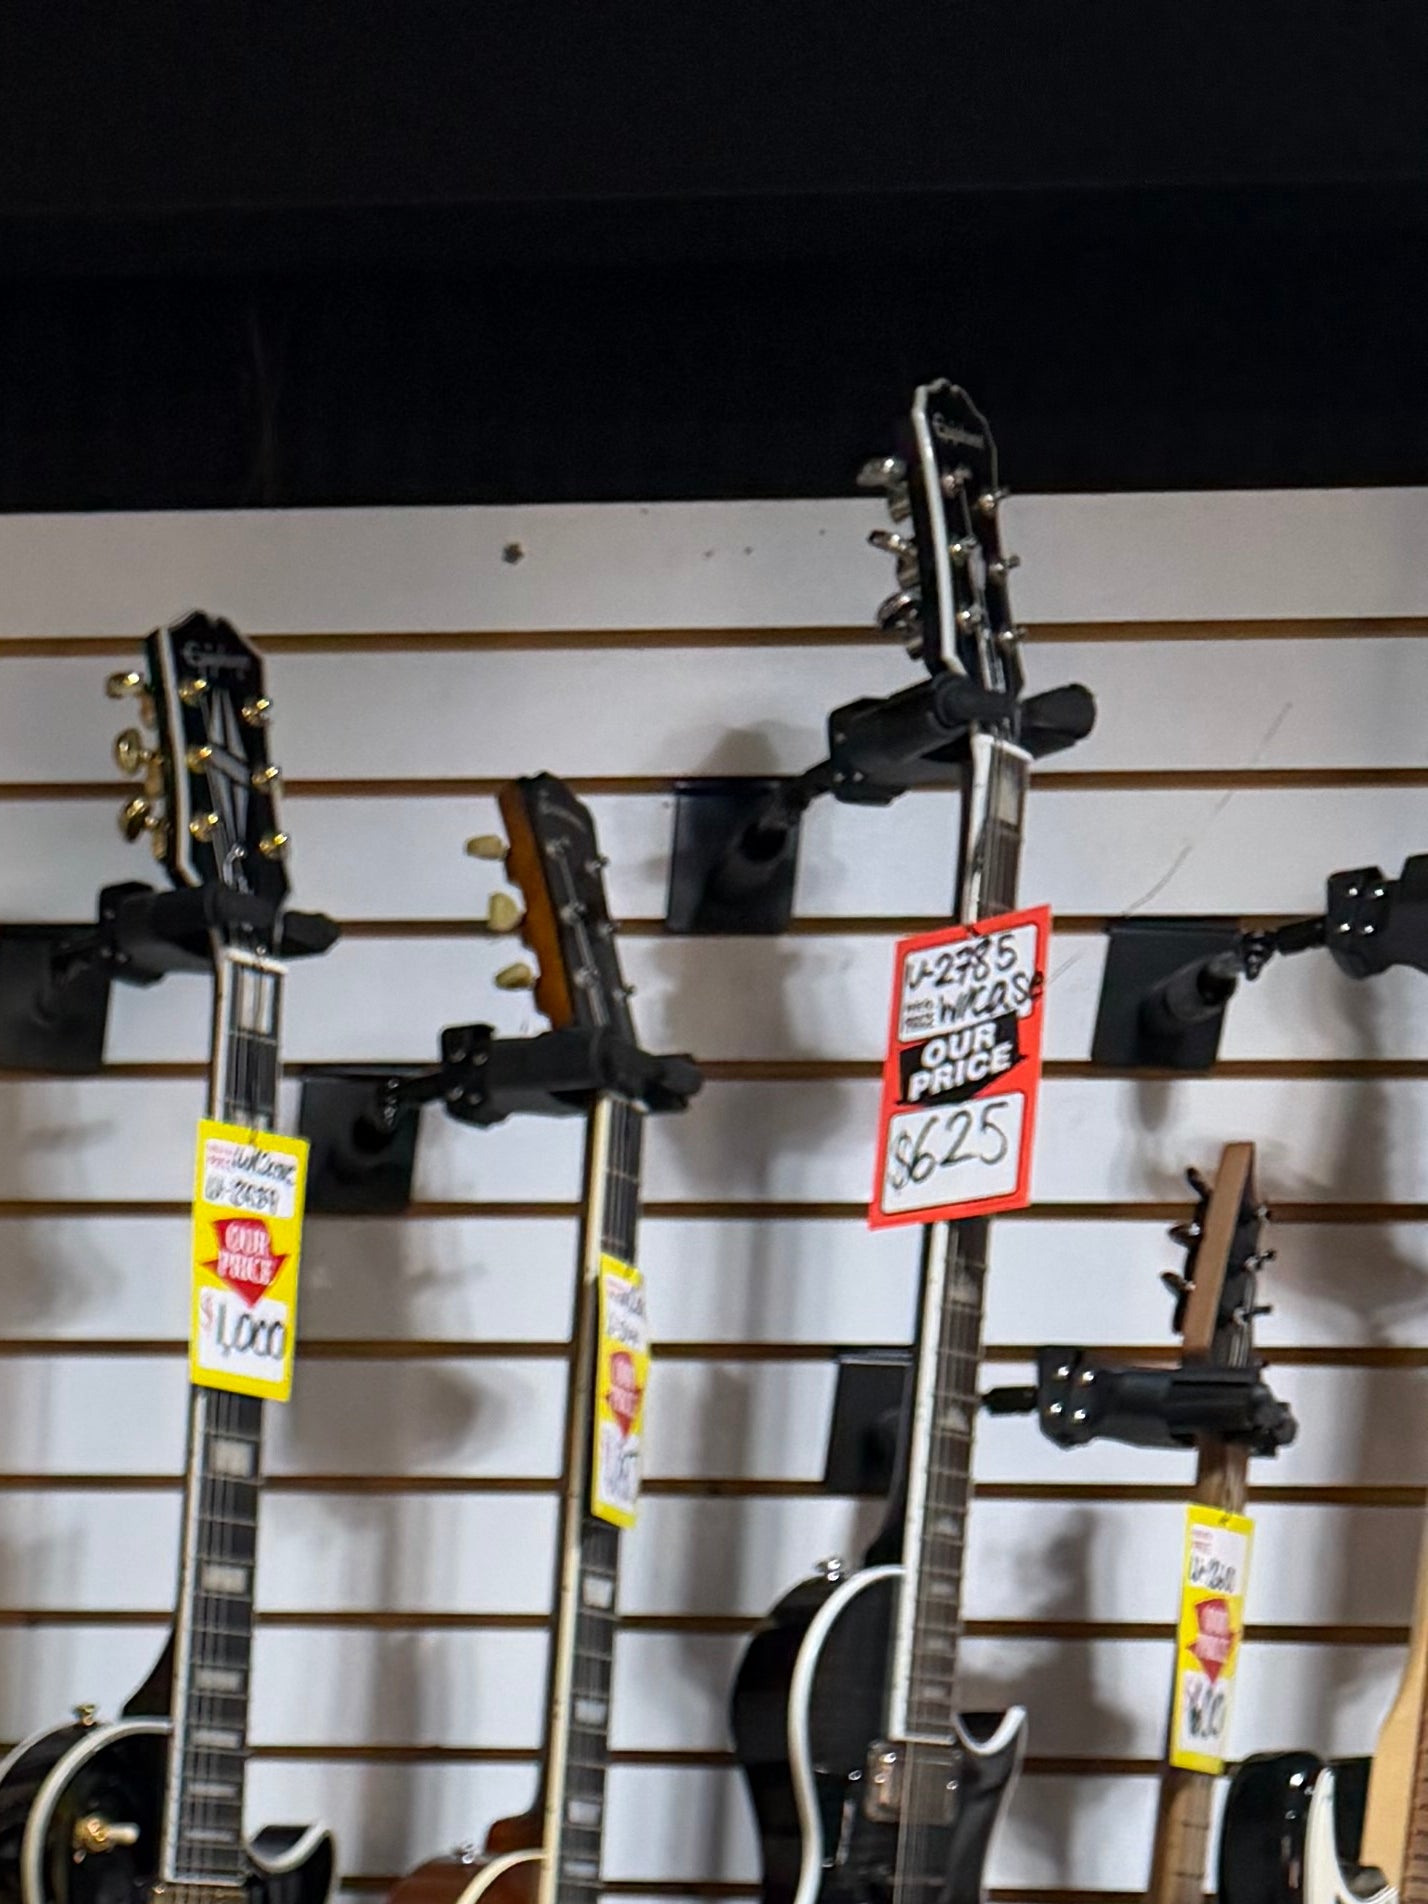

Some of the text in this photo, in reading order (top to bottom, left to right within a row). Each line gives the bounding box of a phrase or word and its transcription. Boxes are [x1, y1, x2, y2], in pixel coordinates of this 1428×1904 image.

[921, 1021, 997, 1068] OUR
[907, 1042, 1013, 1102] PRICE
[888, 1100, 1009, 1192] $625
[225, 1221, 271, 1258] OUR
[217, 1250, 276, 1287] PRICE
